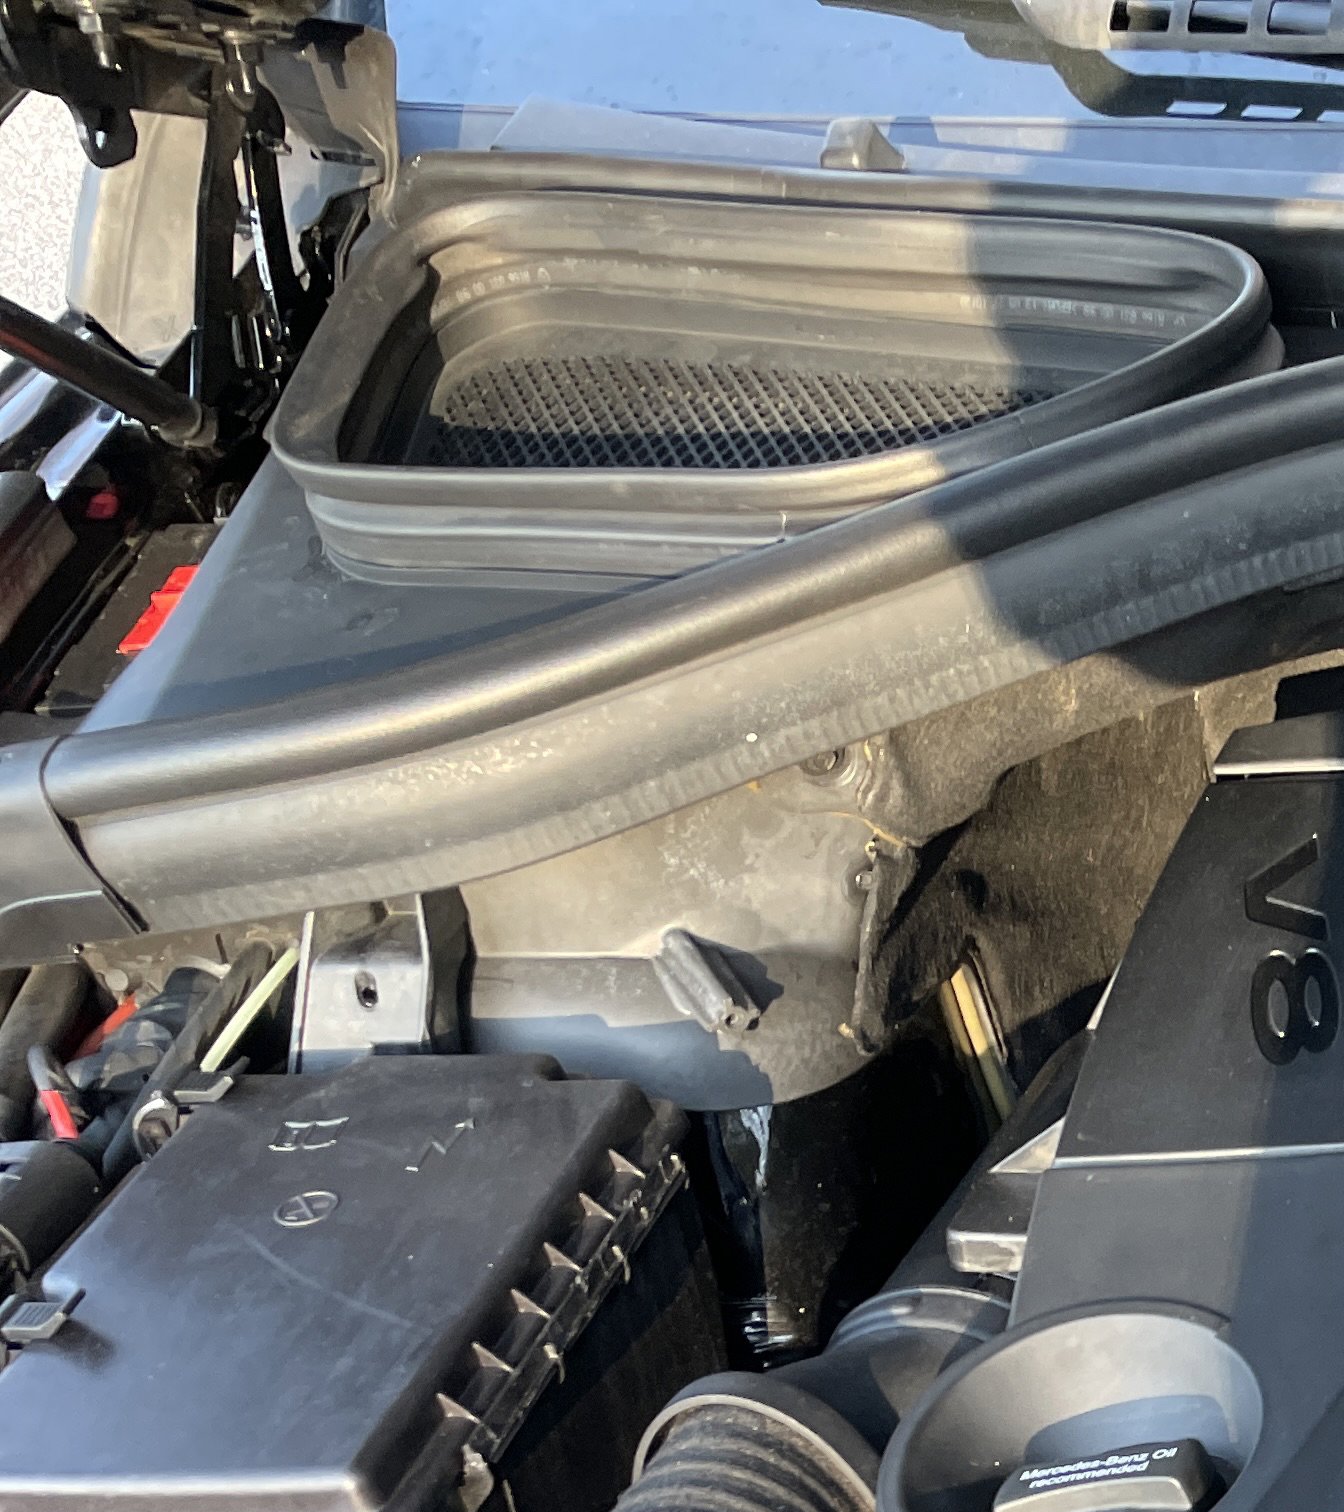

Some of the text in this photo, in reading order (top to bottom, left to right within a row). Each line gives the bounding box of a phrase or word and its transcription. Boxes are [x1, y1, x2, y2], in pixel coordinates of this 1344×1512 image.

[1244, 832, 1342, 1066] V8
[1019, 1447, 1178, 1481] Mercedes-Benz Oil
[1028, 1460, 1150, 1489] recommended
